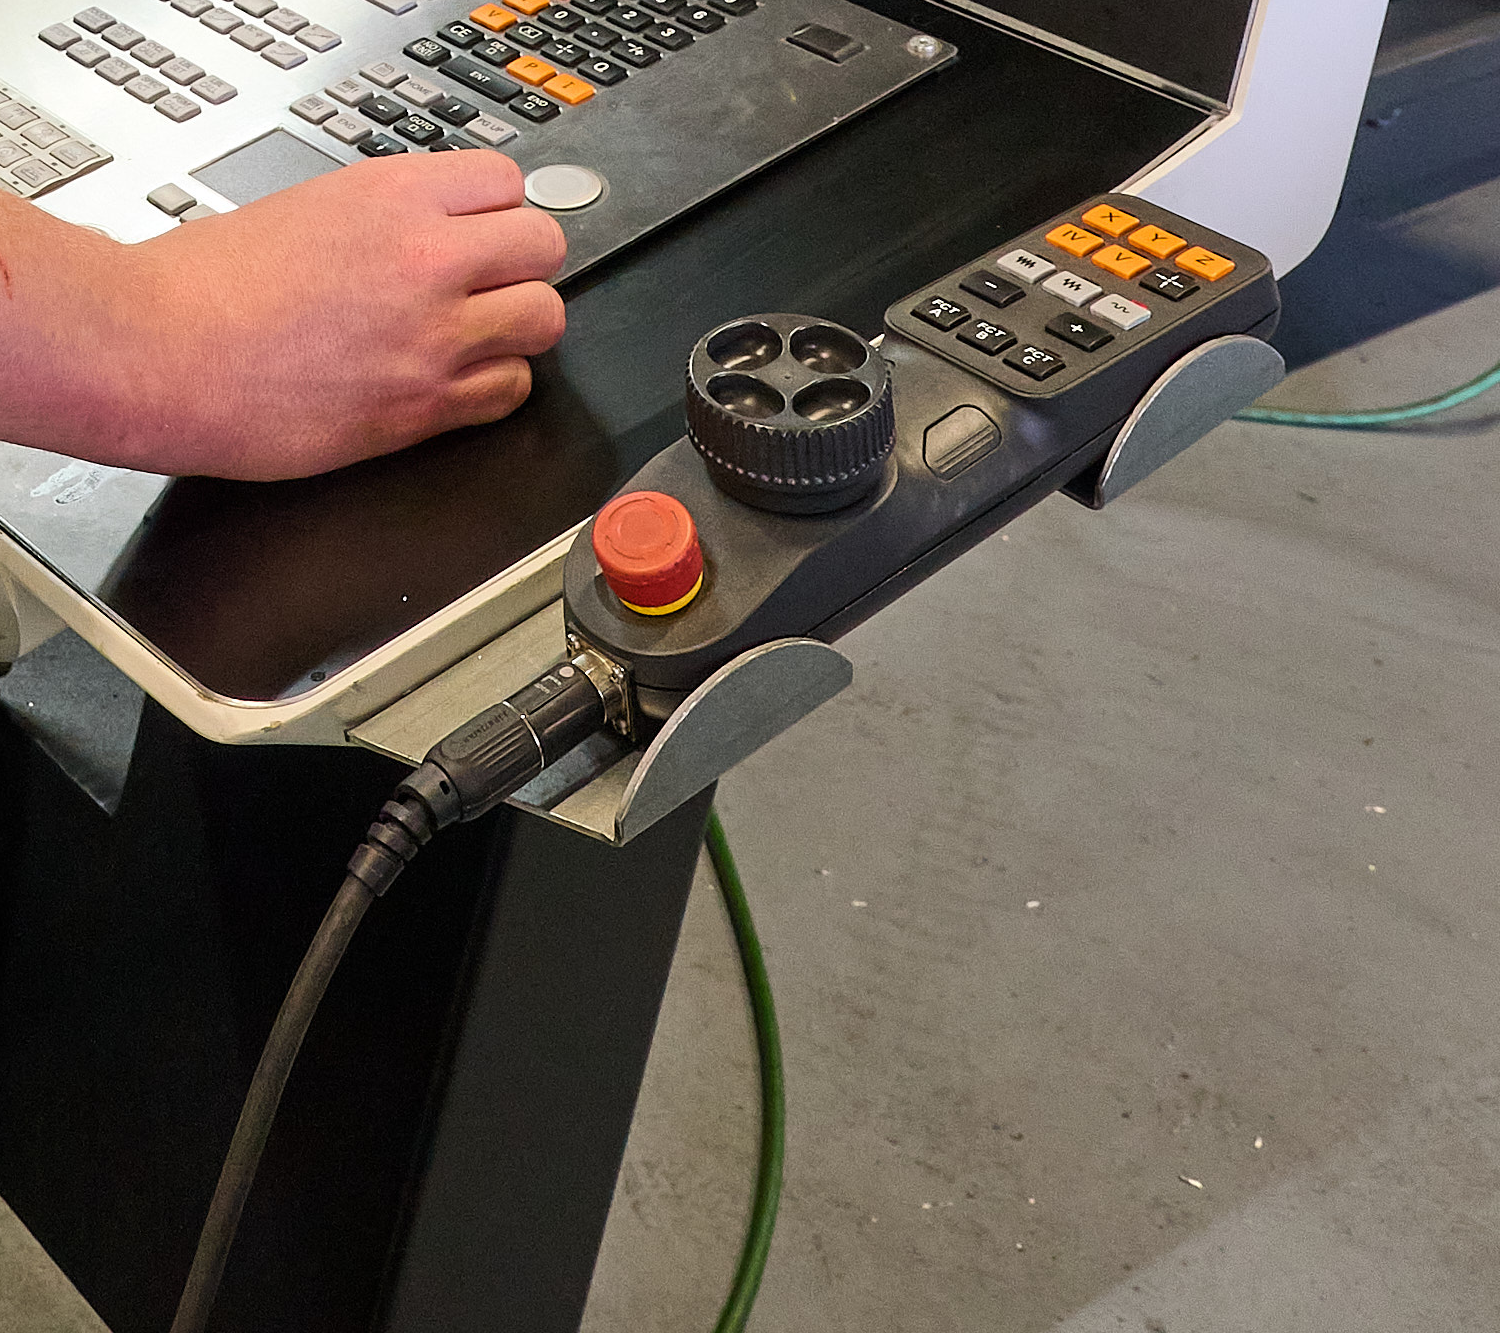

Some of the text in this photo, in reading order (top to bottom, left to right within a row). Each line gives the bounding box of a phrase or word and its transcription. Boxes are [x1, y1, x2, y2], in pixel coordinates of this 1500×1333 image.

[488, 10, 502, 18] V
[554, 10, 569, 19] 0
[622, 10, 638, 20] 2
[693, 10, 708, 20] 6
[450, 24, 472, 38] CE
[661, 27, 676, 37] 3
[490, 41, 508, 52] DEL
[524, 62, 539, 70] P
[593, 61, 609, 73] Q
[469, 71, 491, 83] ENT
[406, 80, 433, 96] HOME
[527, 95, 548, 107] END
[337, 117, 357, 131] END
[409, 115, 435, 131] GOTO
[489, 122, 506, 133] UP
[1100, 211, 1120, 222] X
[1062, 230, 1086, 242] IV
[1151, 232, 1167, 243] Y
[1114, 252, 1132, 263] V
[1195, 255, 1215, 266] Z
[931, 298, 960, 315] FCT
[929, 308, 942, 318] A
[976, 321, 1006, 338] FCT
[975, 330, 989, 341] B
[1022, 355, 1036, 365] C
[1023, 346, 1054, 363] FCT
